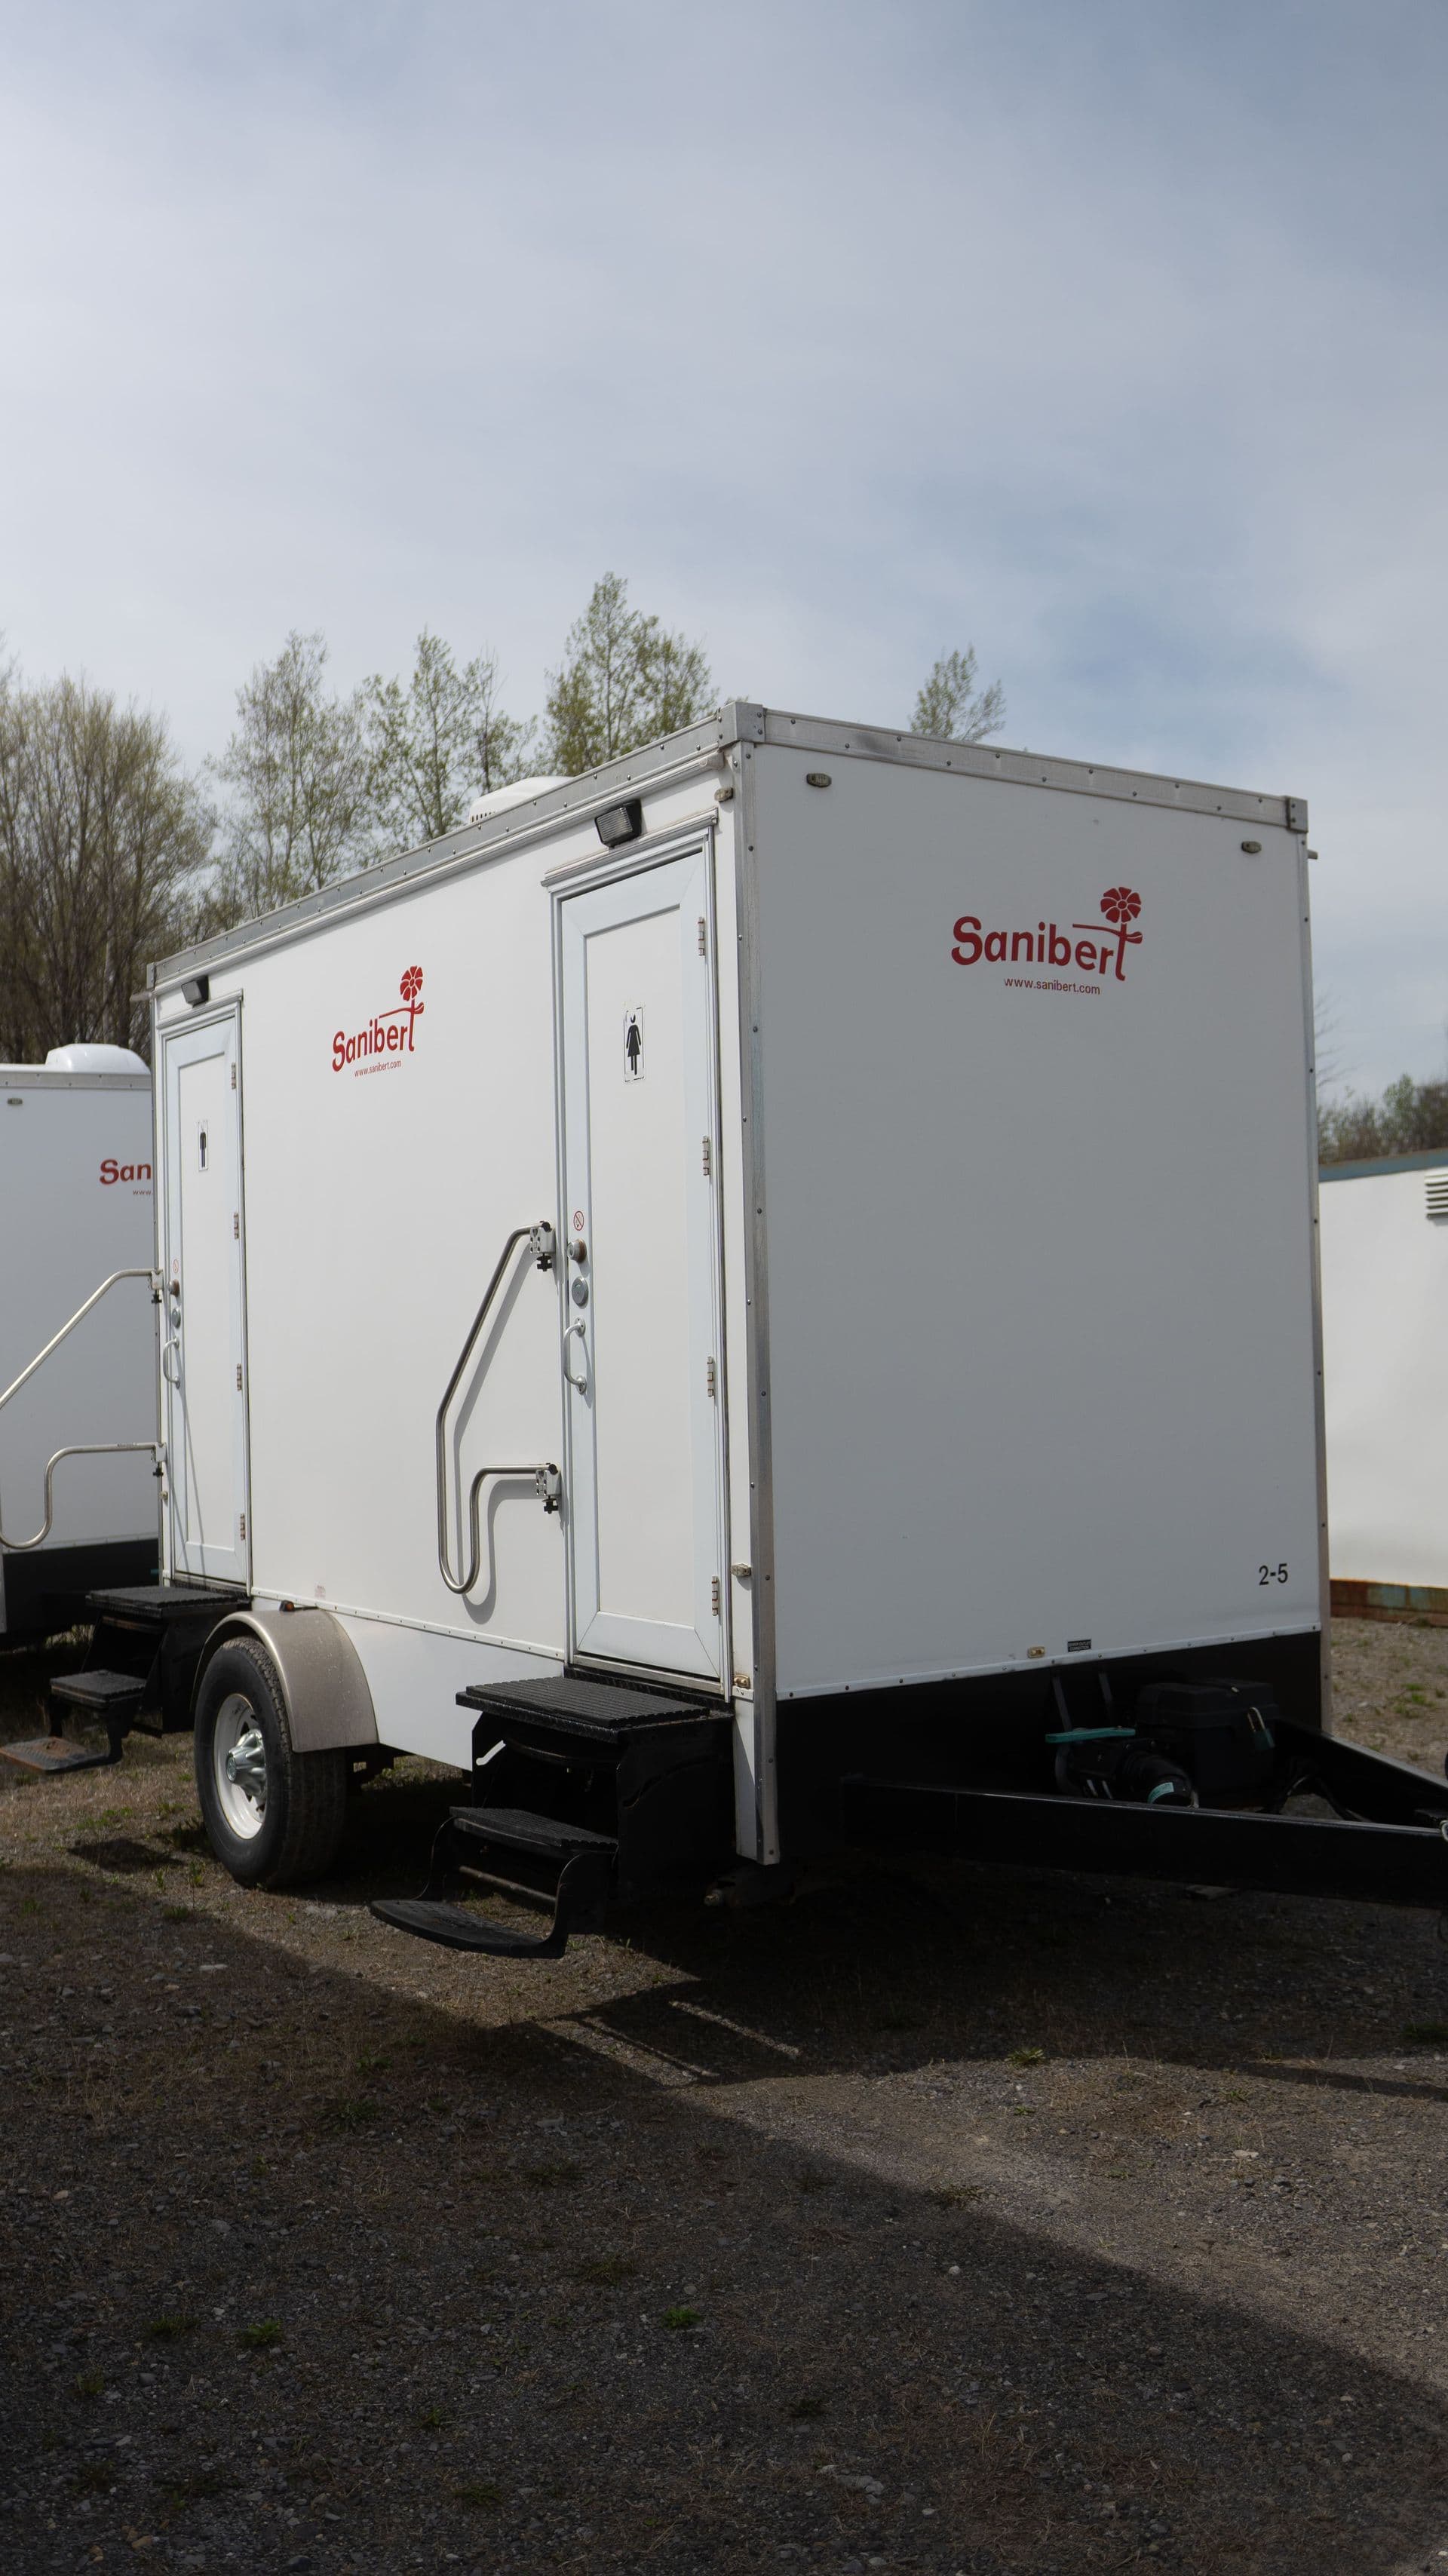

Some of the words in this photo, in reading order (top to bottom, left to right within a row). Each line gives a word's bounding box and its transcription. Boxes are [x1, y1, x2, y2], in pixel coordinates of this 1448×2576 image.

[951, 915, 1143, 982] Sanibert
[1003, 978, 1101, 995] www.sanibert.com
[332, 998, 425, 1072] Sanibert
[354, 1059, 402, 1078] www.sanibert.com
[1259, 1562, 1288, 1586] 2-5
